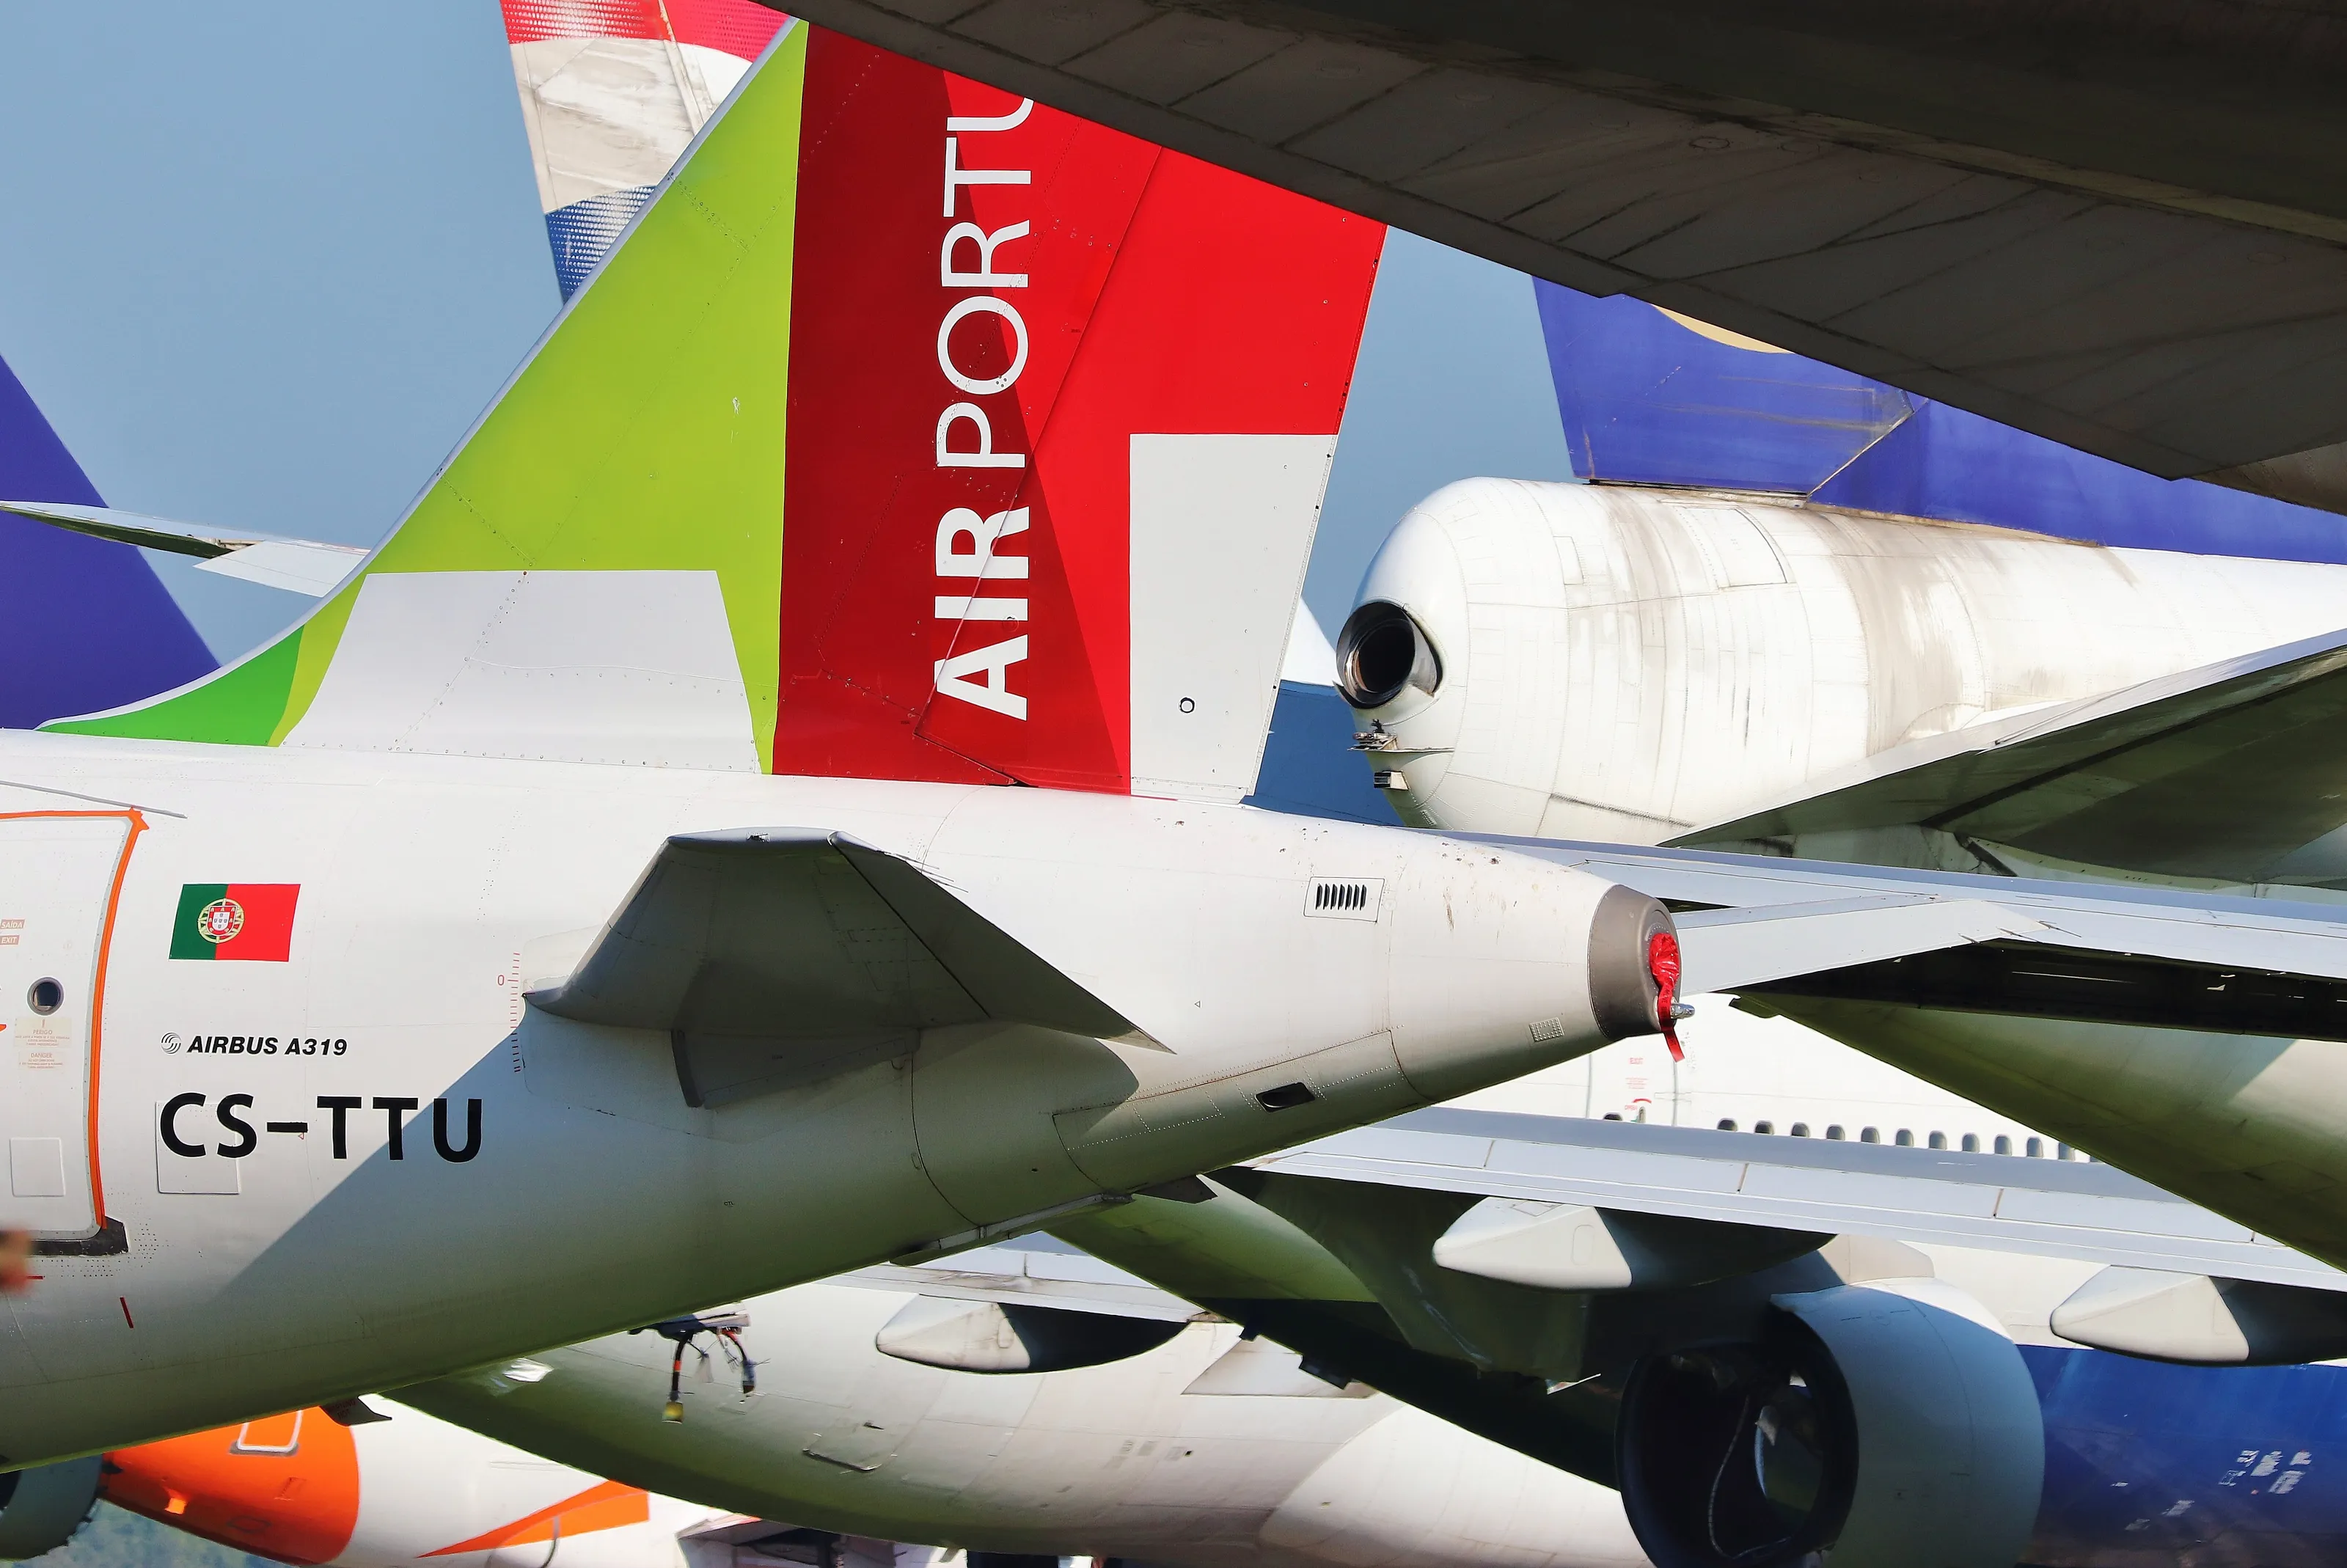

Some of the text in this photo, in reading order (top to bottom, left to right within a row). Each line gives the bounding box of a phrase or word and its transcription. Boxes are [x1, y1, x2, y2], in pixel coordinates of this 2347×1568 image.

[934, 506, 1030, 721] AIR
[186, 1036, 348, 1056] AIRBUS A319
[159, 1091, 483, 1164] CS-TTU
